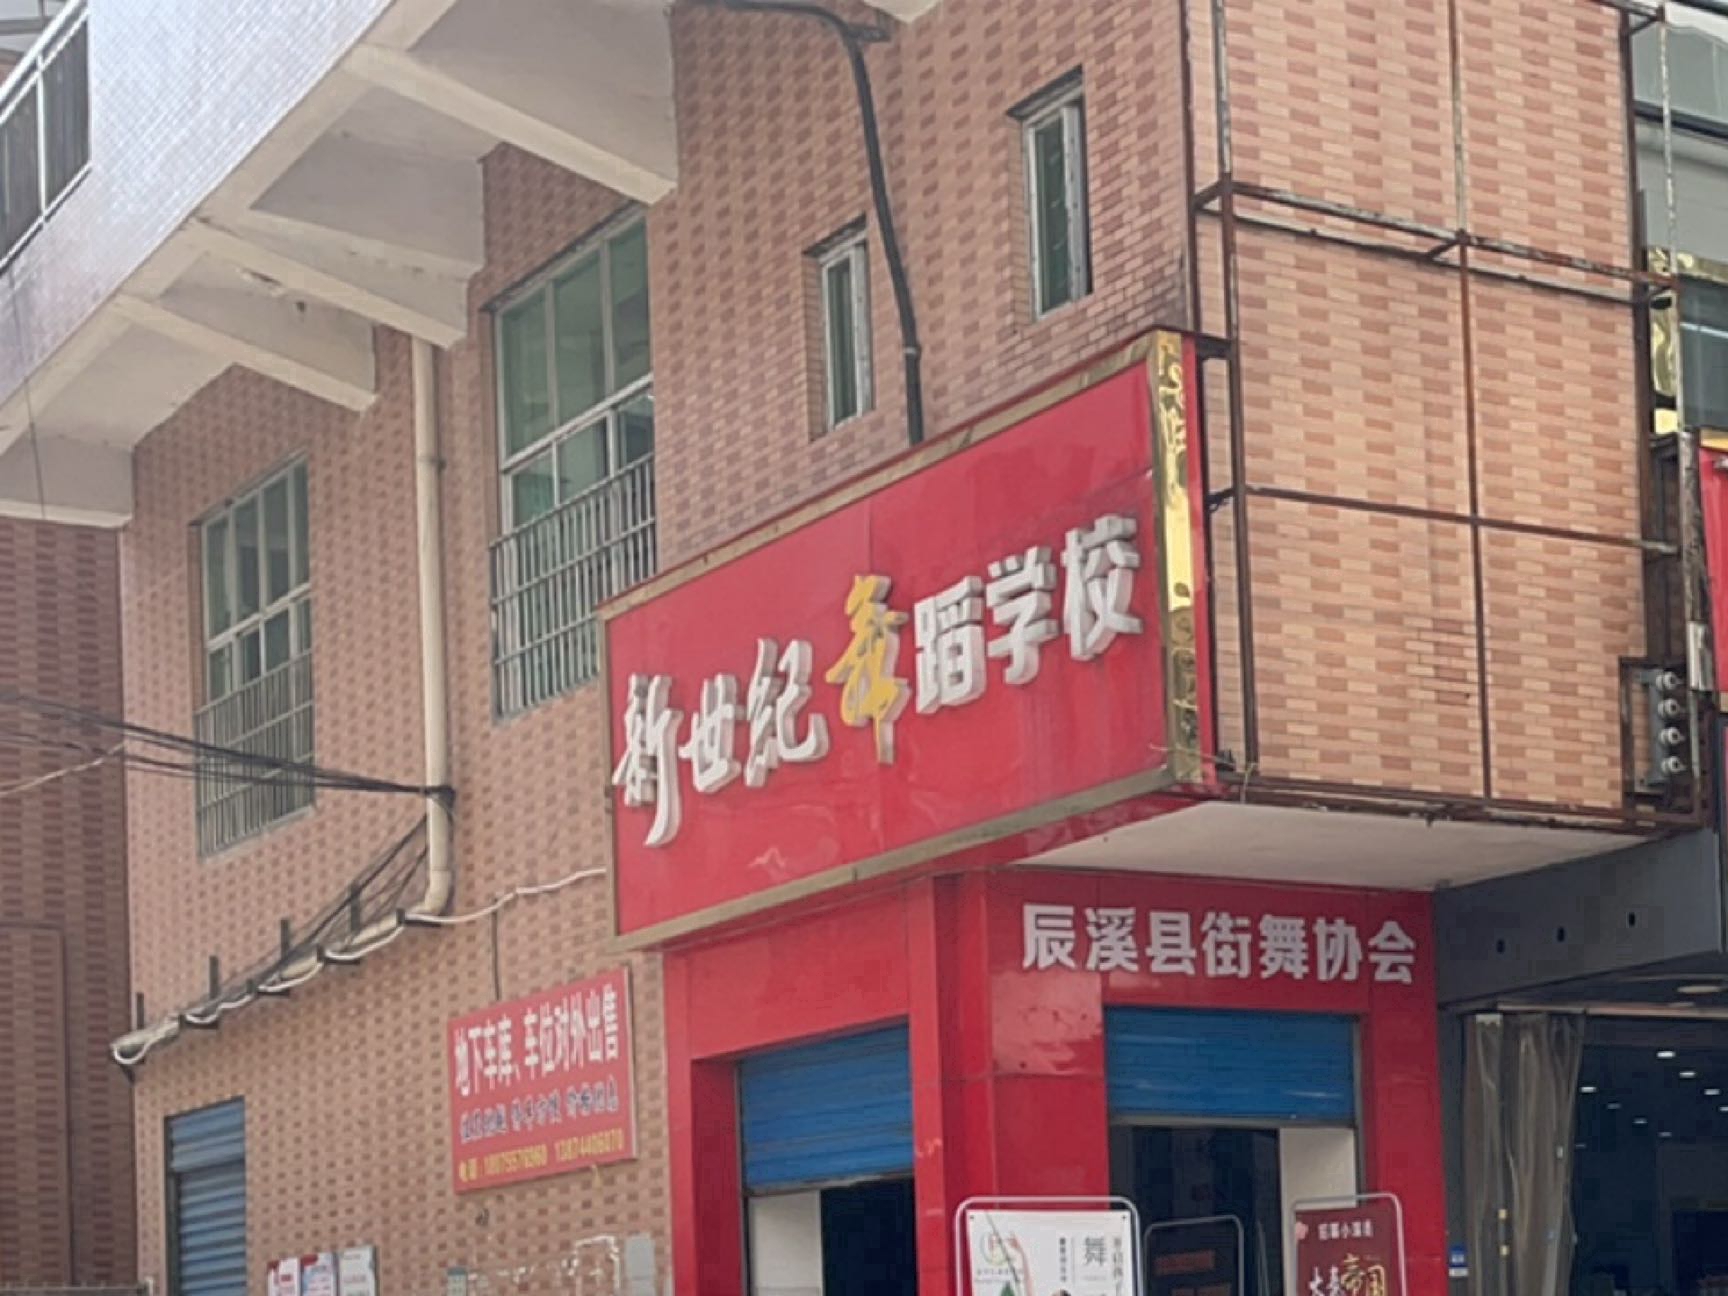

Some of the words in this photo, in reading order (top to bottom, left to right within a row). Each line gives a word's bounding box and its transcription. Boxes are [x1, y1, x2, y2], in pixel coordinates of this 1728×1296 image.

[612, 513, 1142, 846] 新世纪舞蹈学校
[1022, 903, 1417, 985] 辰溪县街舞协会
